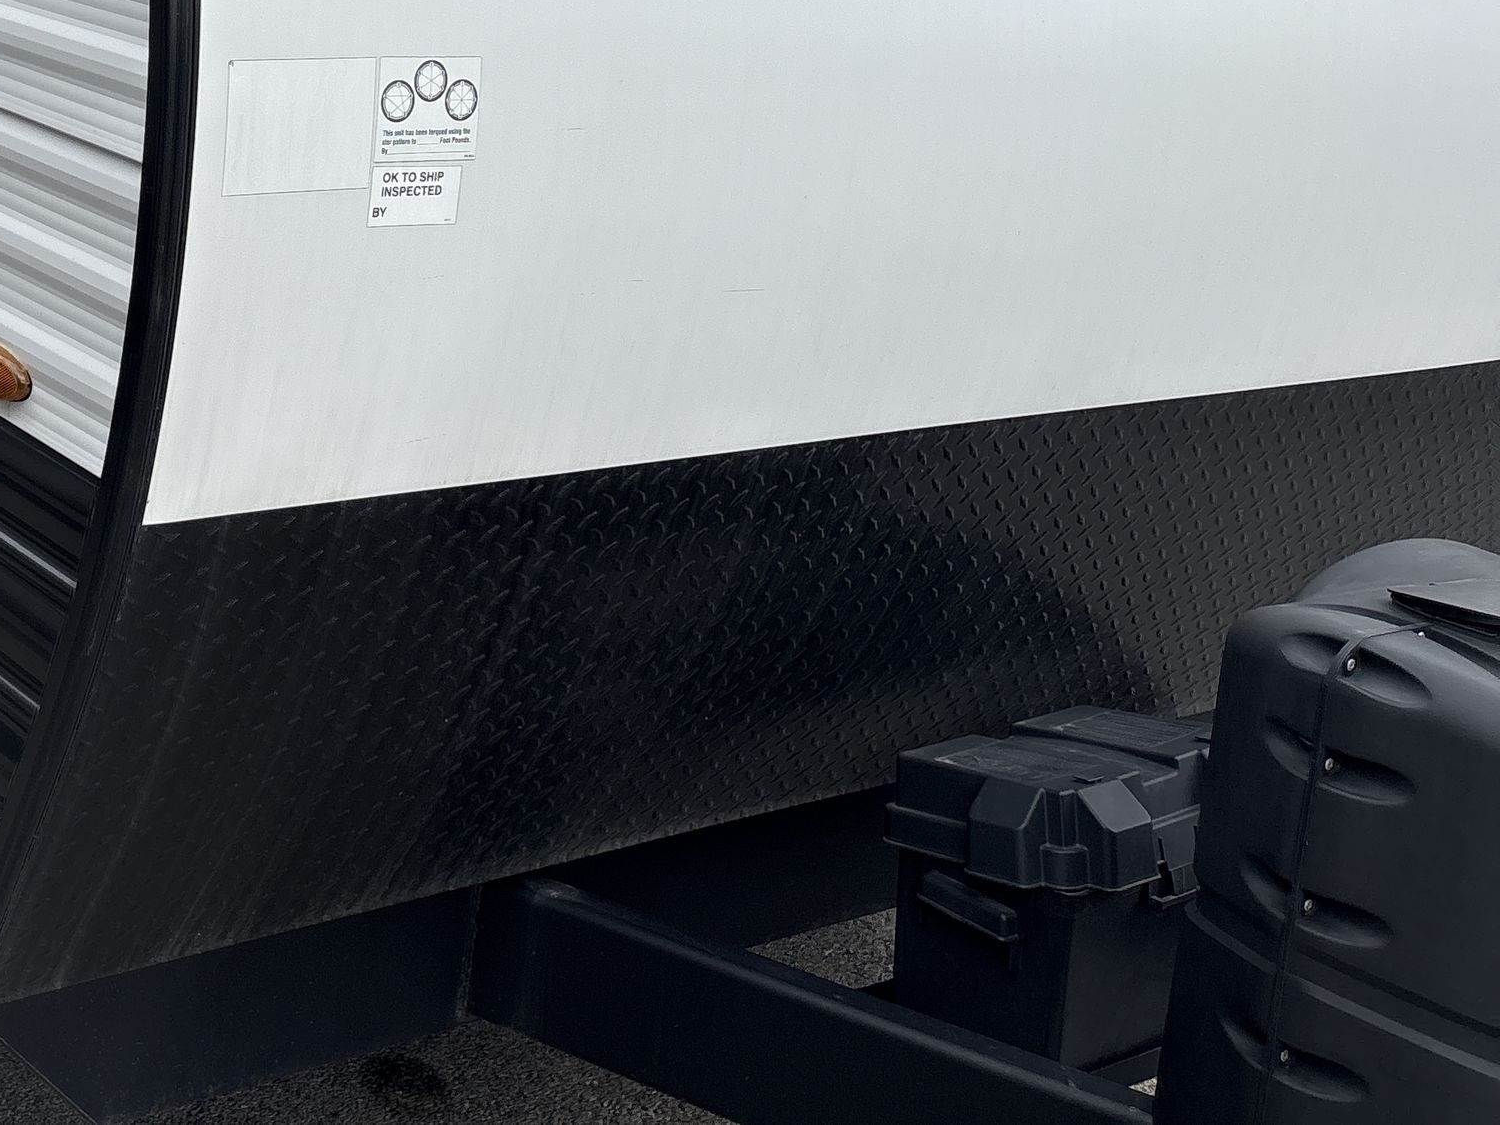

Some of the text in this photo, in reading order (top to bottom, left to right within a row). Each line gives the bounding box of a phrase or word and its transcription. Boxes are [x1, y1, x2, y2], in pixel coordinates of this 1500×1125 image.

[382, 129, 393, 137] This
[382, 171, 445, 183] OK TO SHIP
[381, 185, 443, 197] INSPECTED
[372, 206, 387, 218] BY
